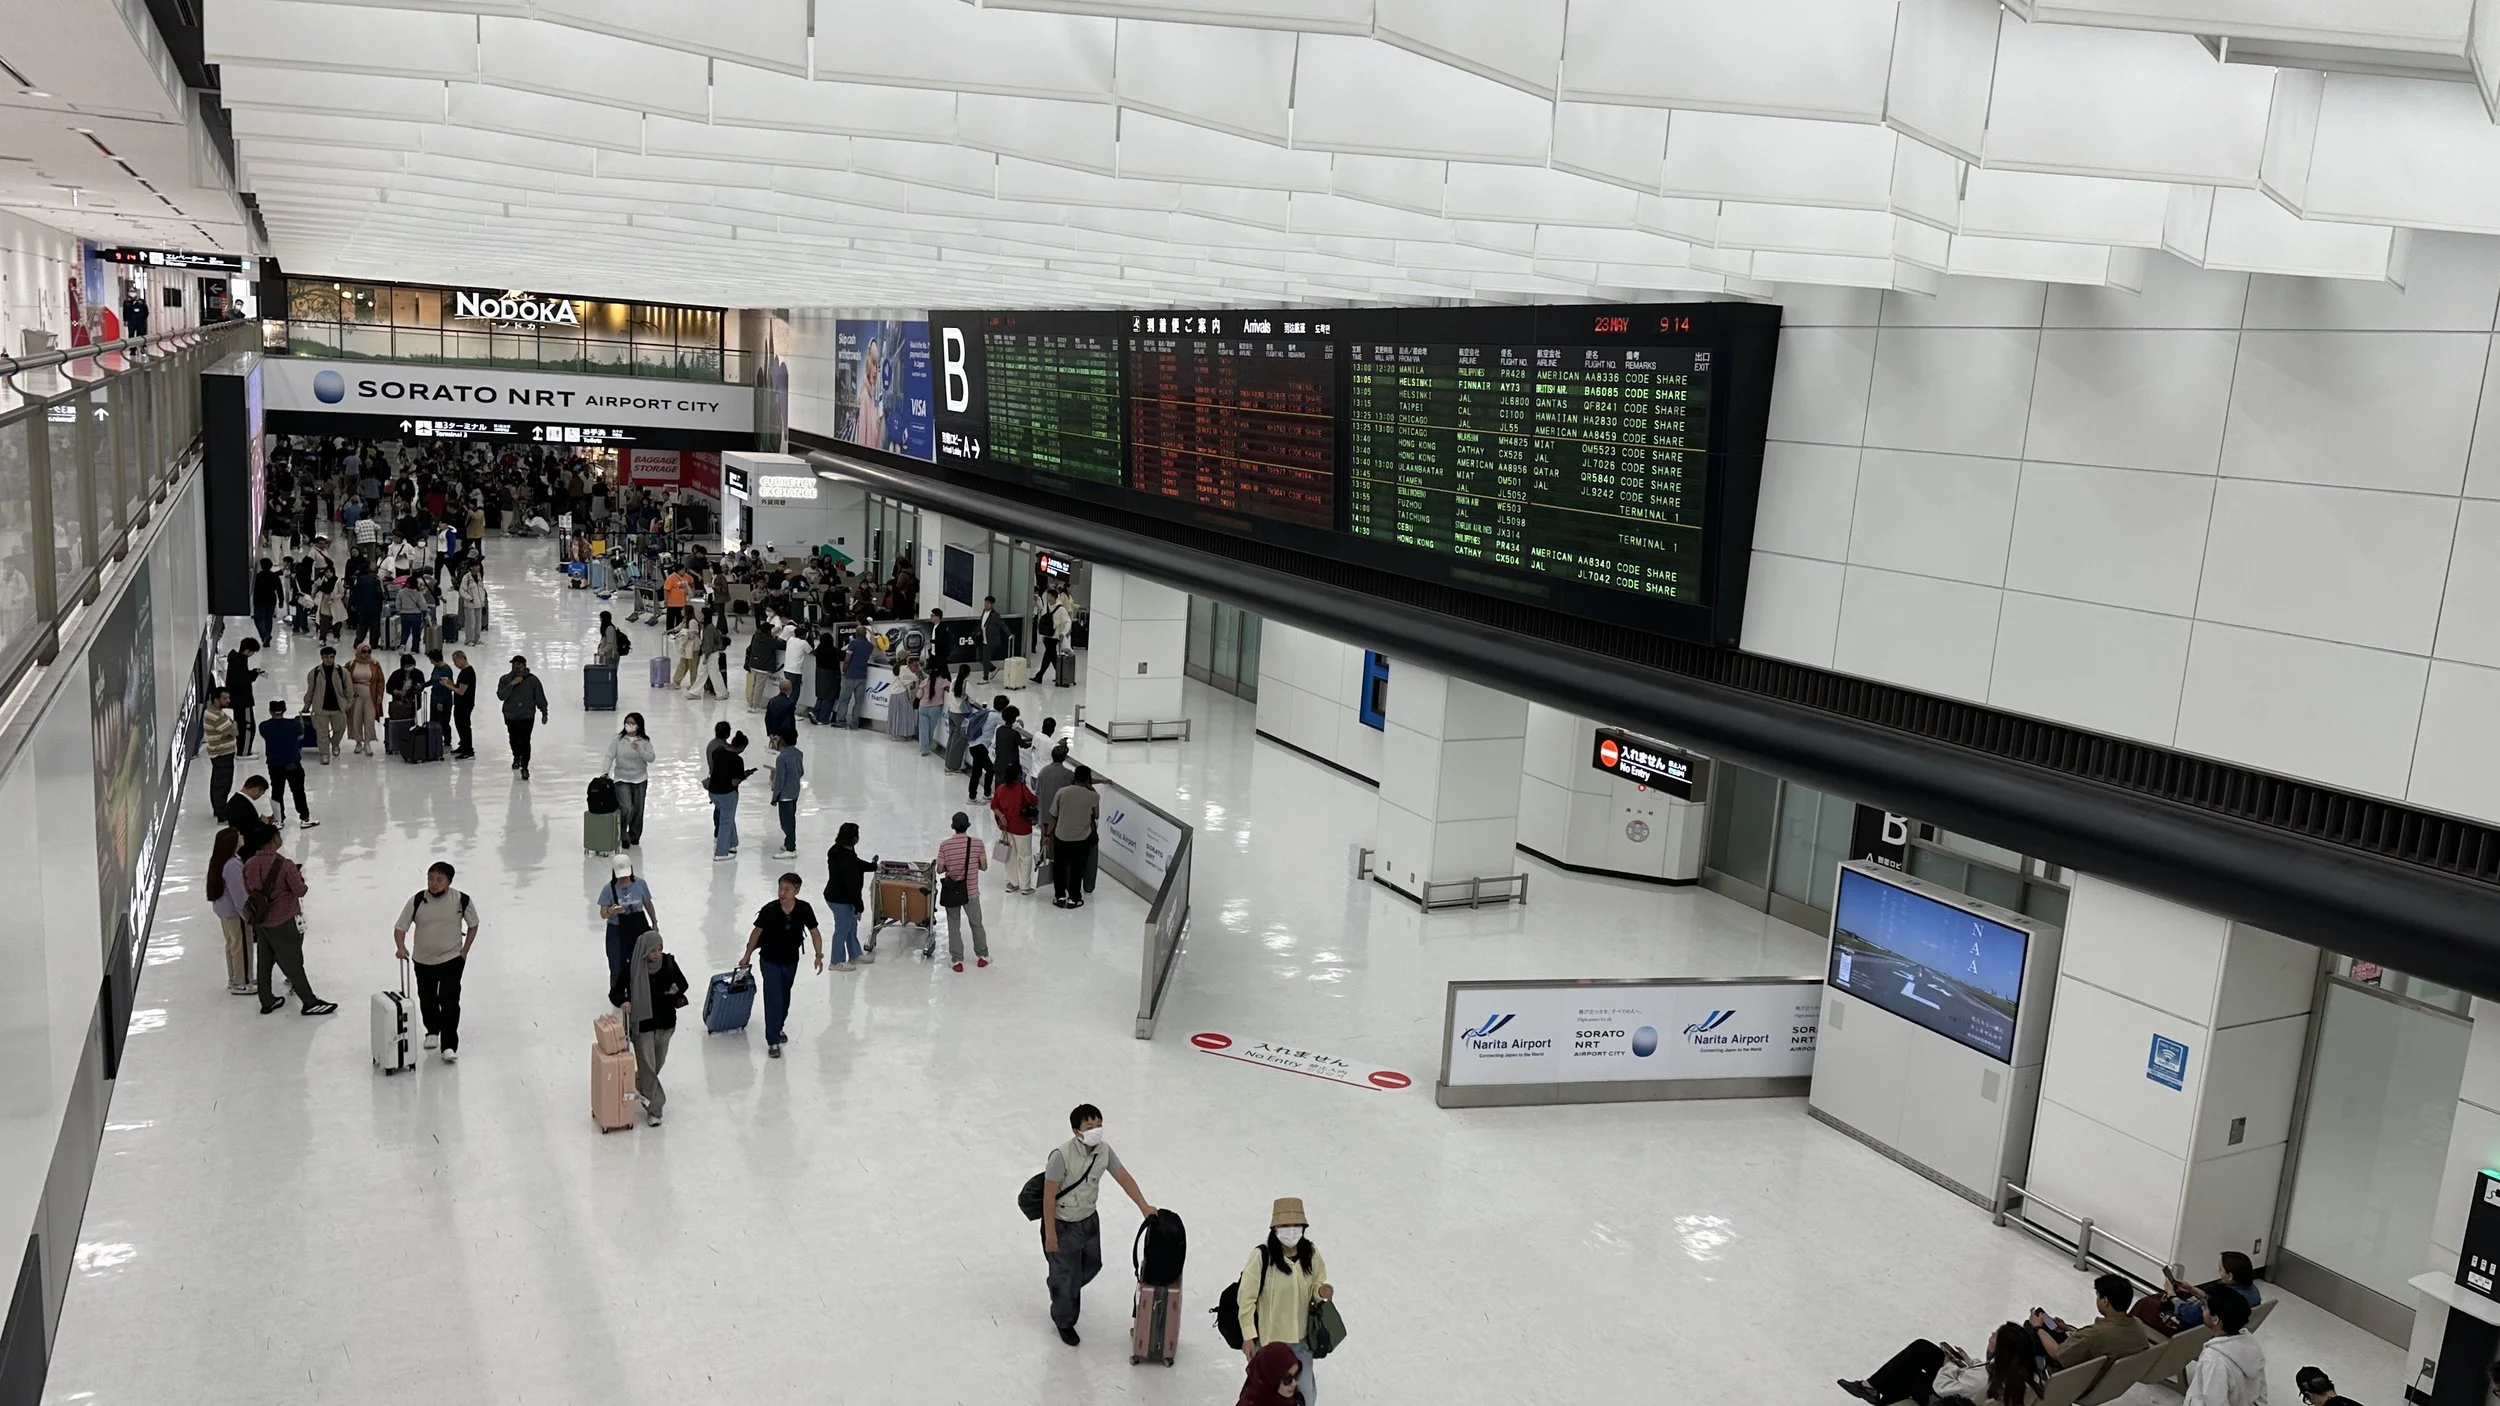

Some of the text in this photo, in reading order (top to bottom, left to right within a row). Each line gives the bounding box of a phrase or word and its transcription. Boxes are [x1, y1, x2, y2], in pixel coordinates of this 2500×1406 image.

[1146, 317, 1220, 334] 到着便ご案内
[1243, 319, 1271, 334] Arrivals
[1660, 317, 1669, 332] 9
[1674, 317, 1690, 332] 14
[1625, 361, 1656, 370] REMARKS
[1694, 363, 1710, 371] EXIT
[1695, 352, 1710, 362] 出口
[942, 328, 969, 412] B
[1500, 368, 1525, 378] PR428
[1537, 370, 1579, 380] AMERICAN
[1625, 373, 1649, 384] CODE
[1656, 374, 1687, 385] SHARE
[358, 380, 720, 413] SORATO NRT AIRPORT CITY
[1458, 380, 1687, 400] FINNAIR AY73 BA6085 CODE SHARE
[911, 398, 926, 417] VISA
[1458, 394, 1471, 402] JAL
[1536, 398, 1567, 408] QANTAS
[1583, 400, 1616, 411] QF8241
[1624, 403, 1648, 414] CODE
[1654, 404, 1686, 416] SHARE
[1458, 406, 1685, 431] CAL CI100 HAWAIIAN HA2830 CODE SHARE
[1458, 419, 1684, 446] JAL JL55 AMERICAN AA8459 CODE SHARE
[963, 436, 971, 458] A
[1498, 436, 1528, 447] MH4825
[1534, 439, 1554, 449] MIAT
[1622, 447, 1645, 459] CODE
[1652, 450, 1683, 462] SHARE
[633, 464, 678, 473] STORAGE
[634, 456, 679, 464] BAGGAGE
[1457, 444, 1484, 454] CATHAY
[1534, 453, 1549, 463] JAL
[1582, 458, 1615, 470] JL7026
[1621, 462, 1645, 473] CODE
[1651, 465, 1682, 477] SHARE
[760, 476, 816, 487] CURRENCY
[1456, 458, 1493, 469] AMERICAN
[1533, 466, 1559, 477] QATAR
[1581, 472, 1614, 484] QR5840
[1620, 476, 1644, 488] CODE
[1650, 480, 1681, 492] SHARE
[760, 487, 817, 498] EXCHANGE
[1456, 470, 1474, 479] MIAT
[1533, 480, 1548, 490] JAL
[1581, 487, 1614, 499] JL9242
[1620, 490, 1643, 503] CODE
[1650, 494, 1680, 508] SHARE
[1456, 483, 1678, 522] JAL JL5052 TERMINAL 1
[1497, 502, 1521, 513] WE503
[1455, 508, 1469, 518] JAL
[1618, 534, 1665, 550] TERMINAL
[1674, 542, 1677, 552] 1
[1496, 528, 1520, 539] JX314
[1496, 540, 1677, 582] PR434 AMERICAN AA8340 CODE SHARE
[1454, 545, 1676, 597] CATHAY CX504 JAL JL7042 CODE SHARE
[1621, 746, 1665, 770] 入れません
[1620, 762, 1650, 781] No Entry
[1473, 1038, 1551, 1050] Narita Airport
[1694, 1034, 1769, 1046] Narita Airport
[1245, 1050, 1302, 1067] No Entry
[1254, 1043, 1349, 1067] 入れません
